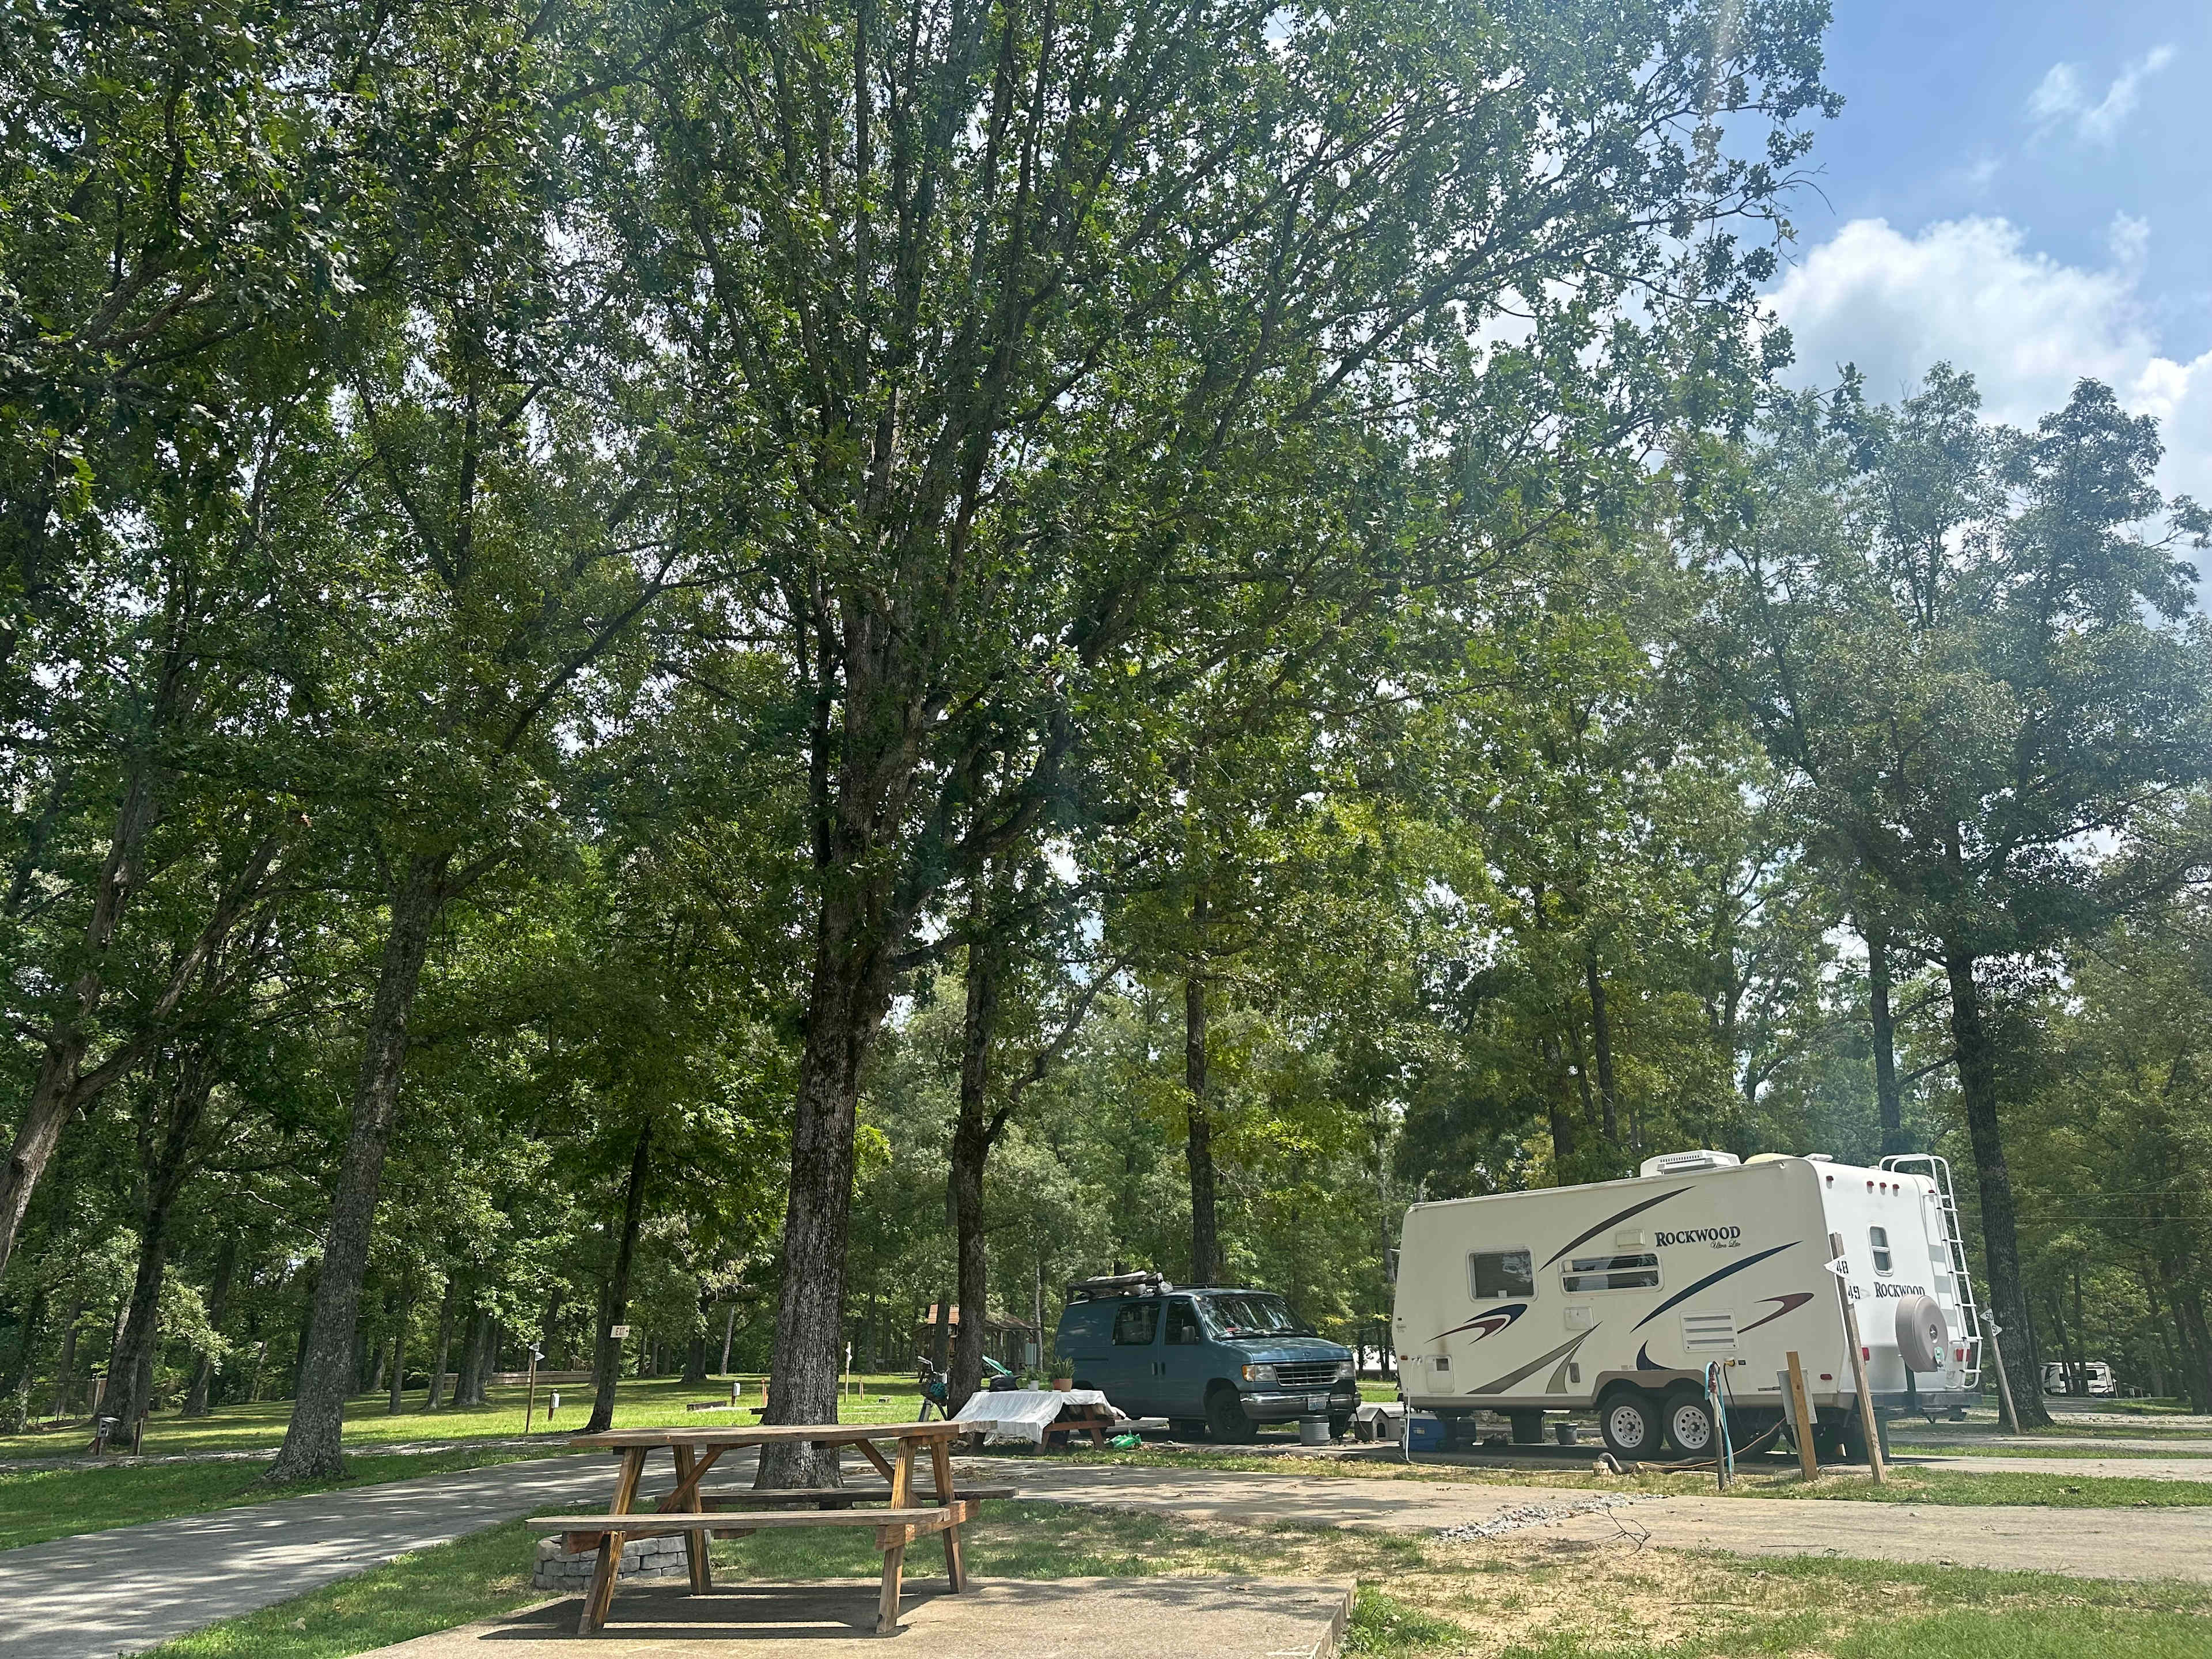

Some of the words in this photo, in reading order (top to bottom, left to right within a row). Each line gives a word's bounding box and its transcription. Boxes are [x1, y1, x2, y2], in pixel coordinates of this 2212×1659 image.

[1654, 1226, 1741, 1247] ROCKWOOD
[1836, 1260, 1849, 1274] 48
[1848, 1285, 1861, 1300] 49
[1986, 1312, 1993, 1320] 50
[1992, 1325, 1998, 1334] 51
